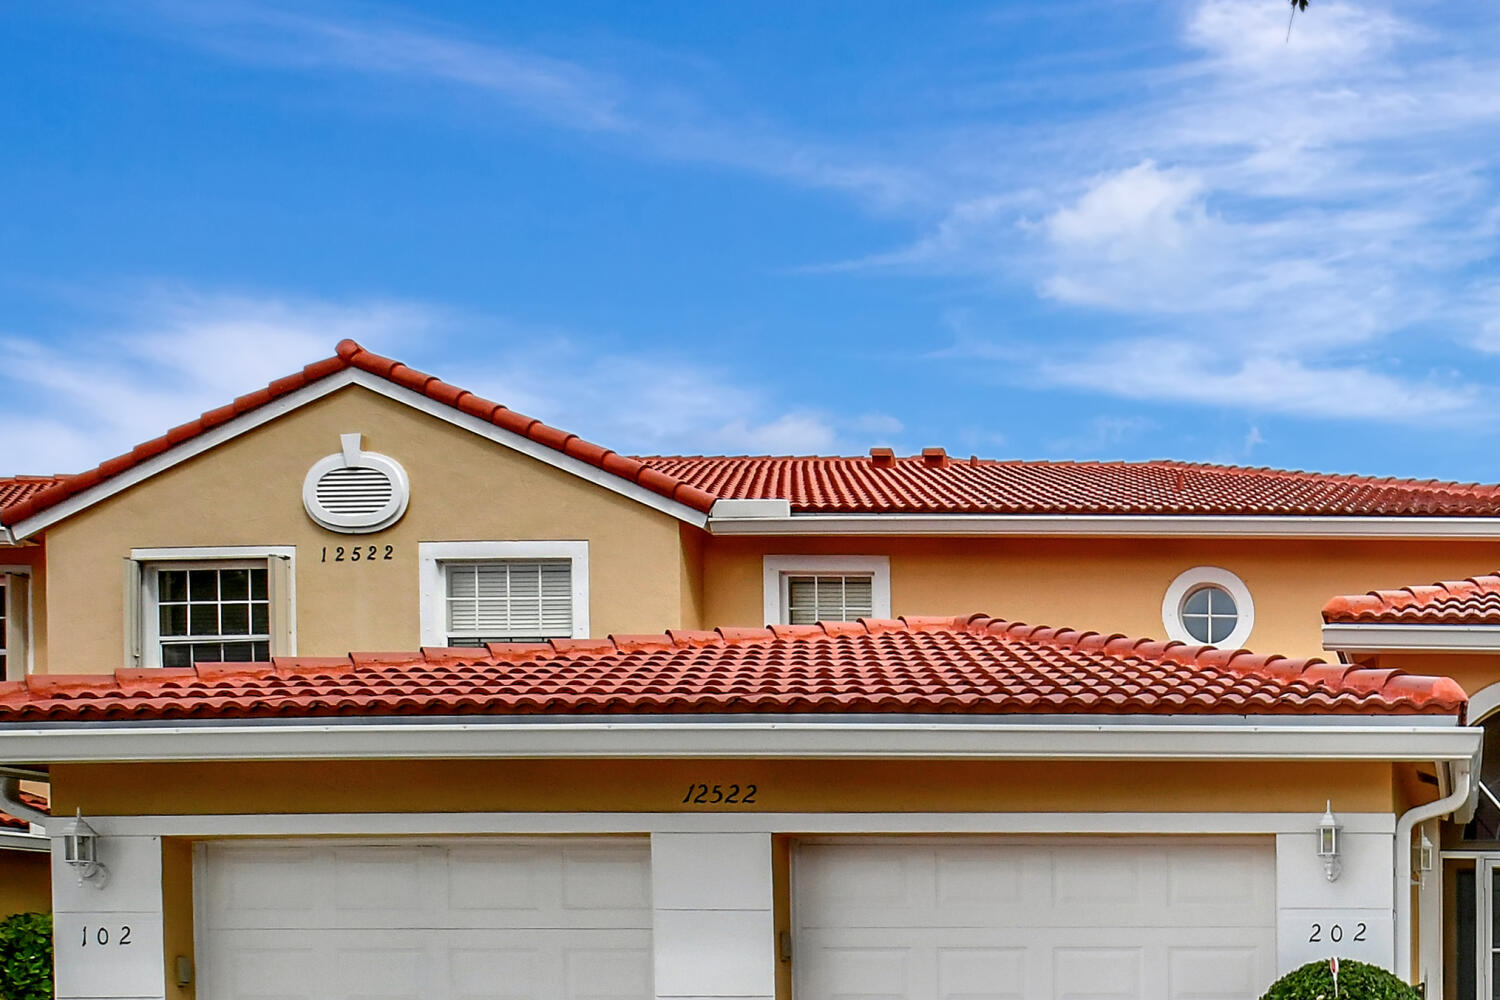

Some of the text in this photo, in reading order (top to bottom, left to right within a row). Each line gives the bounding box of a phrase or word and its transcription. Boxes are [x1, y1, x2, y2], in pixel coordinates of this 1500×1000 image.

[321, 545, 393, 562] 12522
[682, 784, 757, 803] 12522
[82, 926, 131, 947] 102
[1309, 923, 1366, 943] 202
